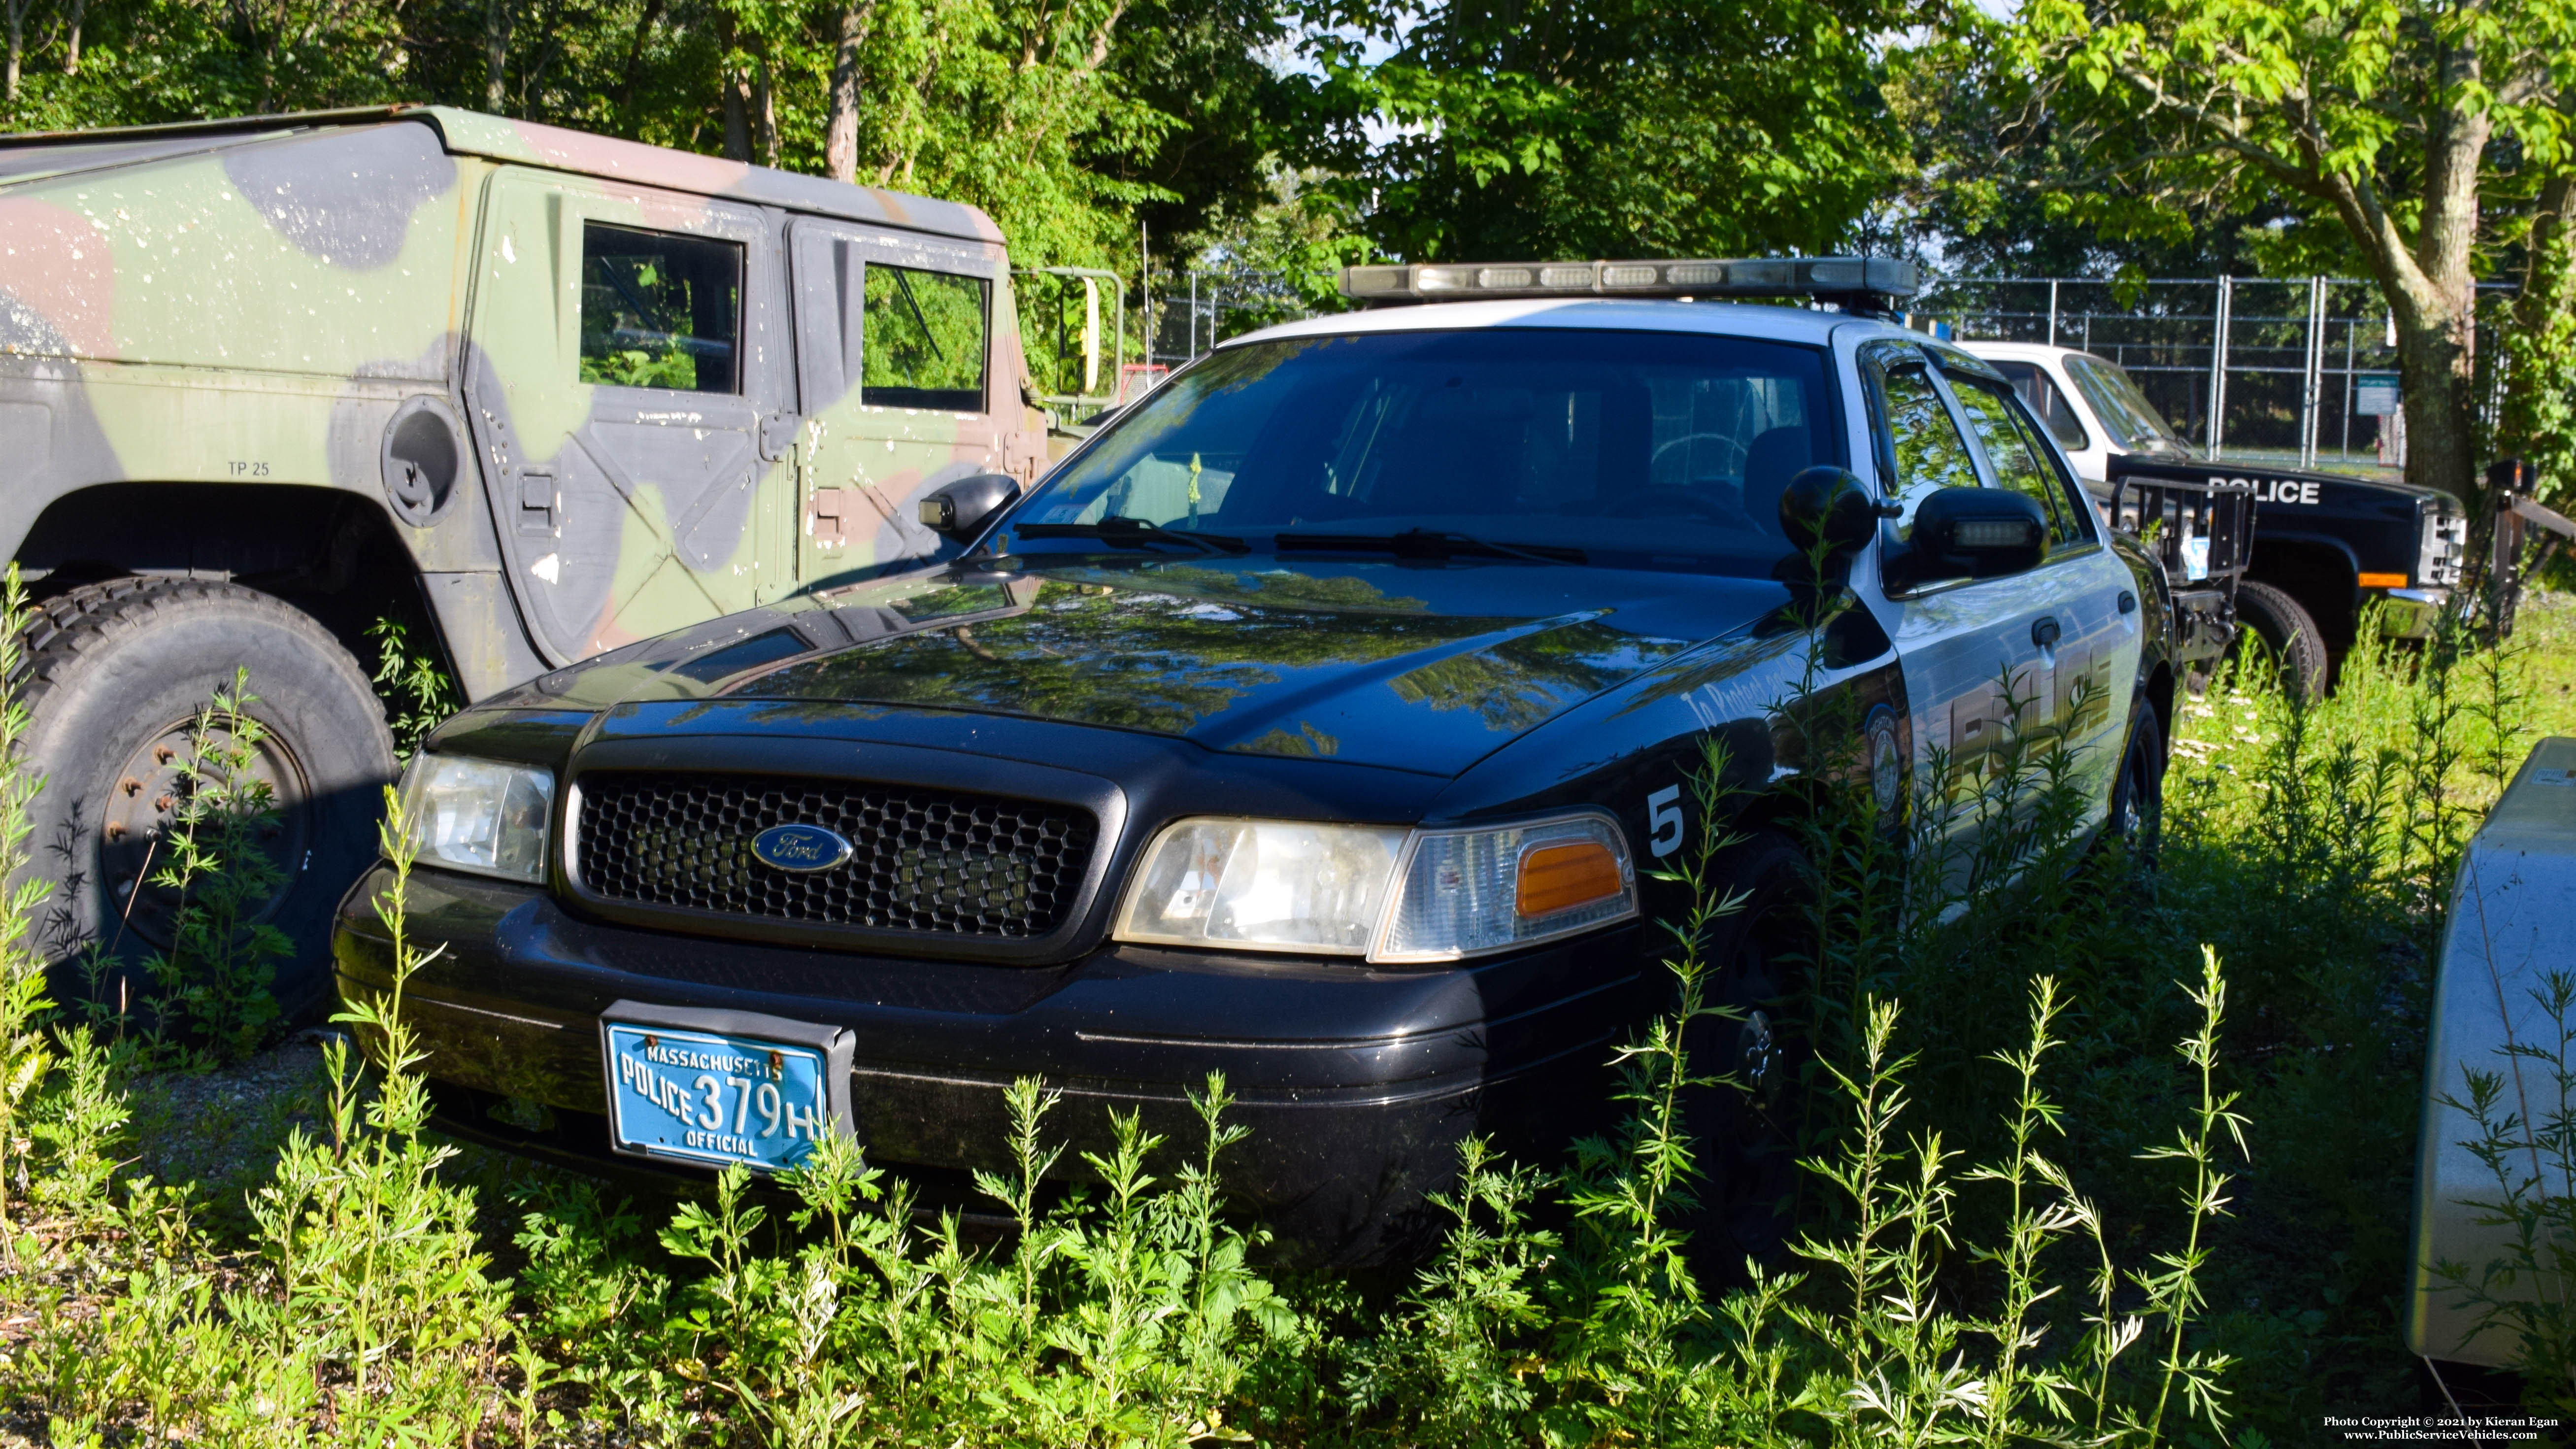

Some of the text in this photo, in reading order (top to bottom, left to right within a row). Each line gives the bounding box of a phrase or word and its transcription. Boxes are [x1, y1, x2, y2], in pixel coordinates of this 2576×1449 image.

[228, 462, 268, 476] TP 25
[1680, 692, 1717, 732] To
[1870, 716, 1895, 741] DIGHTON
[1647, 783, 1683, 858] 5
[772, 833, 824, 861] Ford
[647, 1046, 783, 1081] MASSACHUSETTS
[620, 1052, 693, 1126] POLICE
[686, 1129, 758, 1157] OFFICIAL
